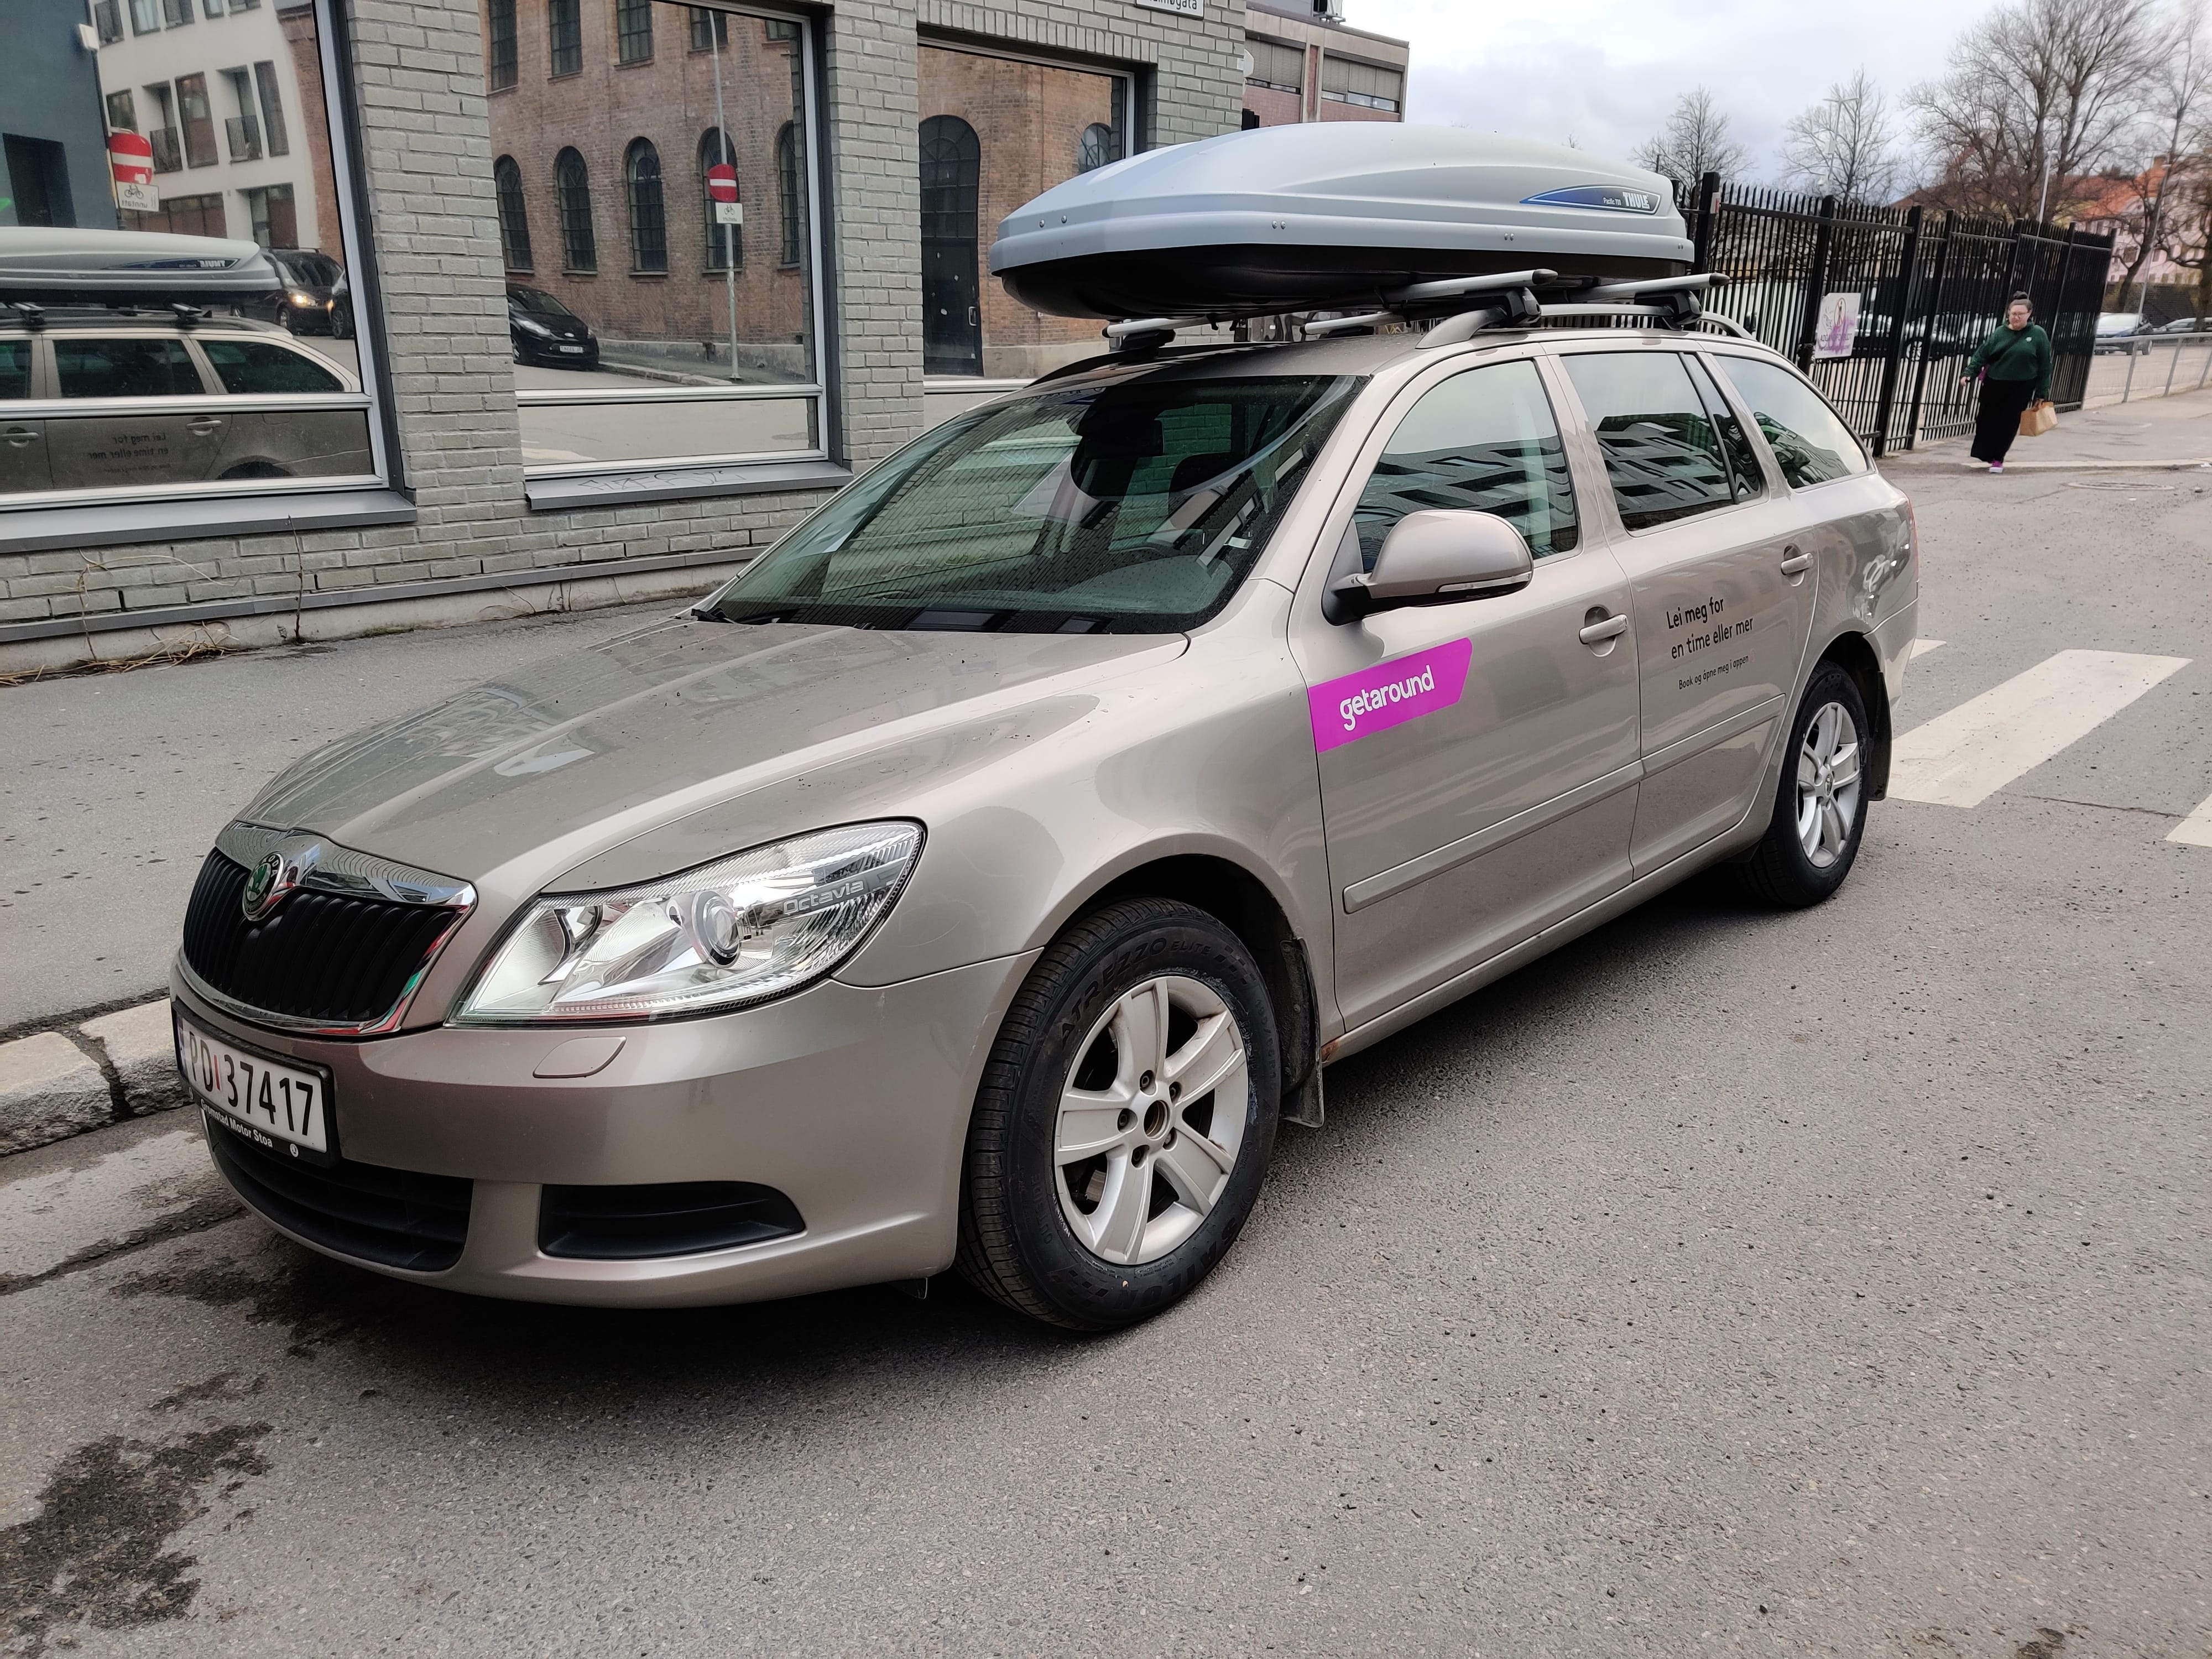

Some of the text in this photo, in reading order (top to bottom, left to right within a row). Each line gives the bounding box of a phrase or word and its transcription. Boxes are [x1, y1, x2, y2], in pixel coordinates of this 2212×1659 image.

[1623, 191, 1651, 210] THULE
[1666, 596, 1724, 629] Lei meg for
[1671, 617, 1754, 659] en time eller mer
[1679, 675, 1693, 690] Book
[1694, 674, 1702, 685] og
[1703, 669, 1717, 682] åpne
[1718, 663, 1729, 674] meg
[1733, 655, 1749, 670] appen
[1339, 664, 1435, 731] getaround
[783, 880, 864, 916] Octavia
[1061, 936, 1212, 1051] ATREZZO ELITE
[189, 1030, 314, 1136] PD 37417
[200, 1098, 273, 1148] Gromstad Motor Stoa
[1113, 1217, 1239, 1311] SAILUN
